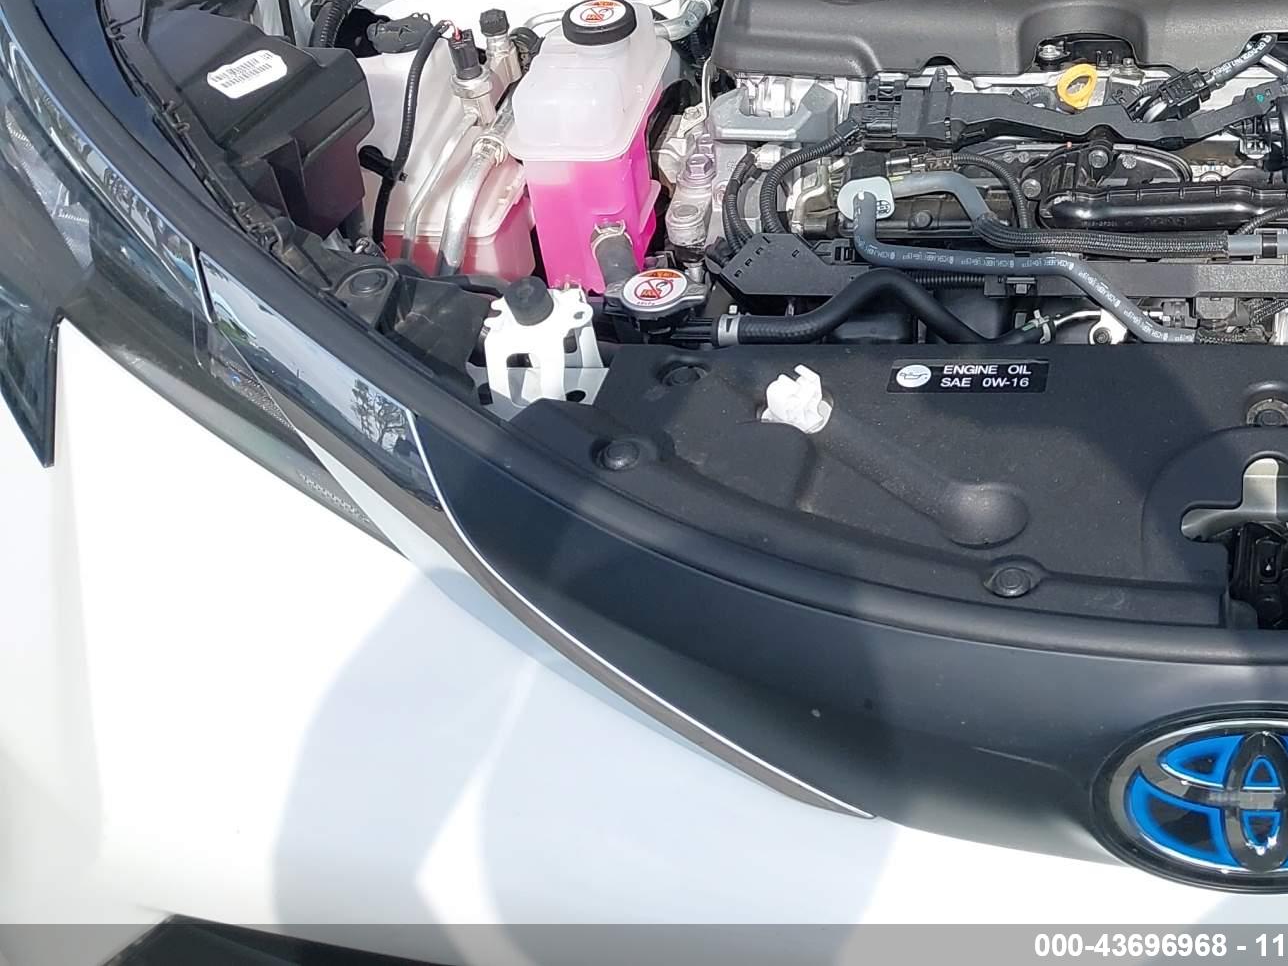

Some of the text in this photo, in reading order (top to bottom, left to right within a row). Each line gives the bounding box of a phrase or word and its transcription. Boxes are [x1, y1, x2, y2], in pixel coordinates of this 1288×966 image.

[943, 364, 1032, 376] ENGINE OIL
[940, 377, 972, 388] SAE
